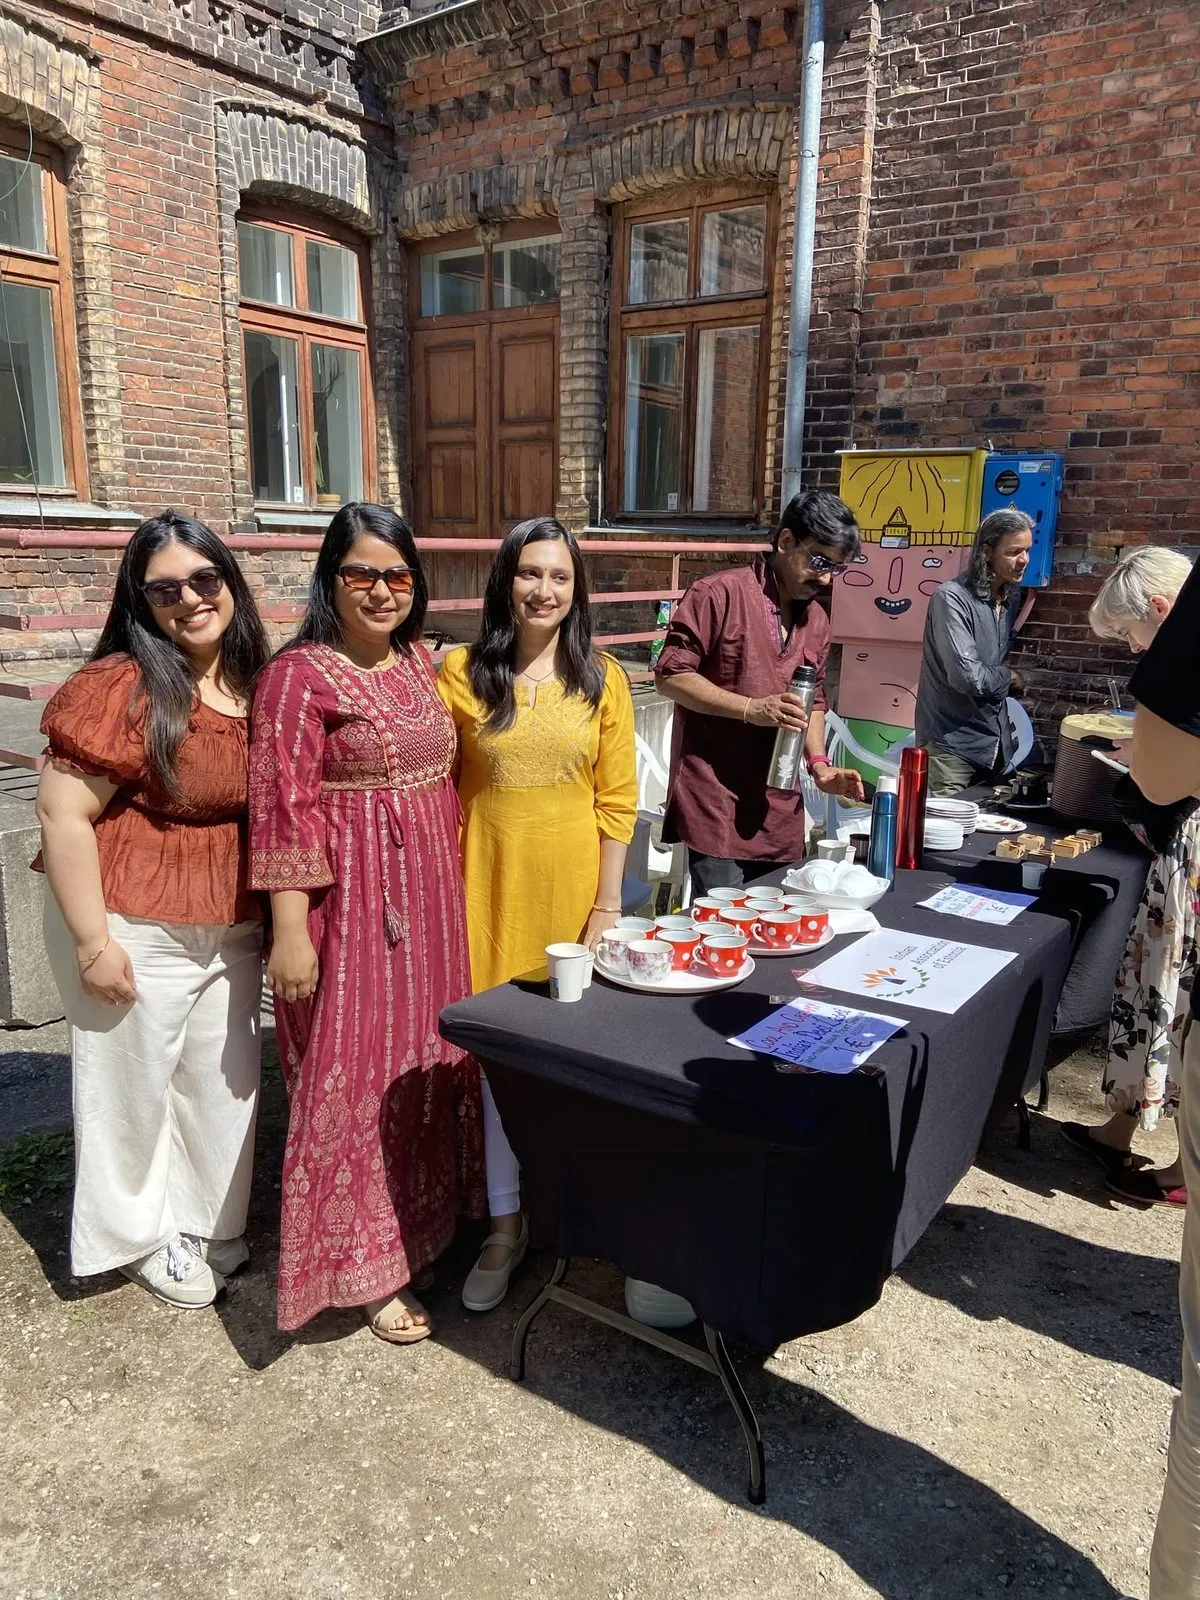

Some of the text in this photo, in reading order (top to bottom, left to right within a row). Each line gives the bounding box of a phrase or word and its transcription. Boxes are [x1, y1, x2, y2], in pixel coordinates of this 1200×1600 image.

[888, 946, 918, 960] Indian
[910, 940, 951, 964] Association
[932, 947, 967, 969] of Estonia
[834, 1037, 874, 1057] 1€
